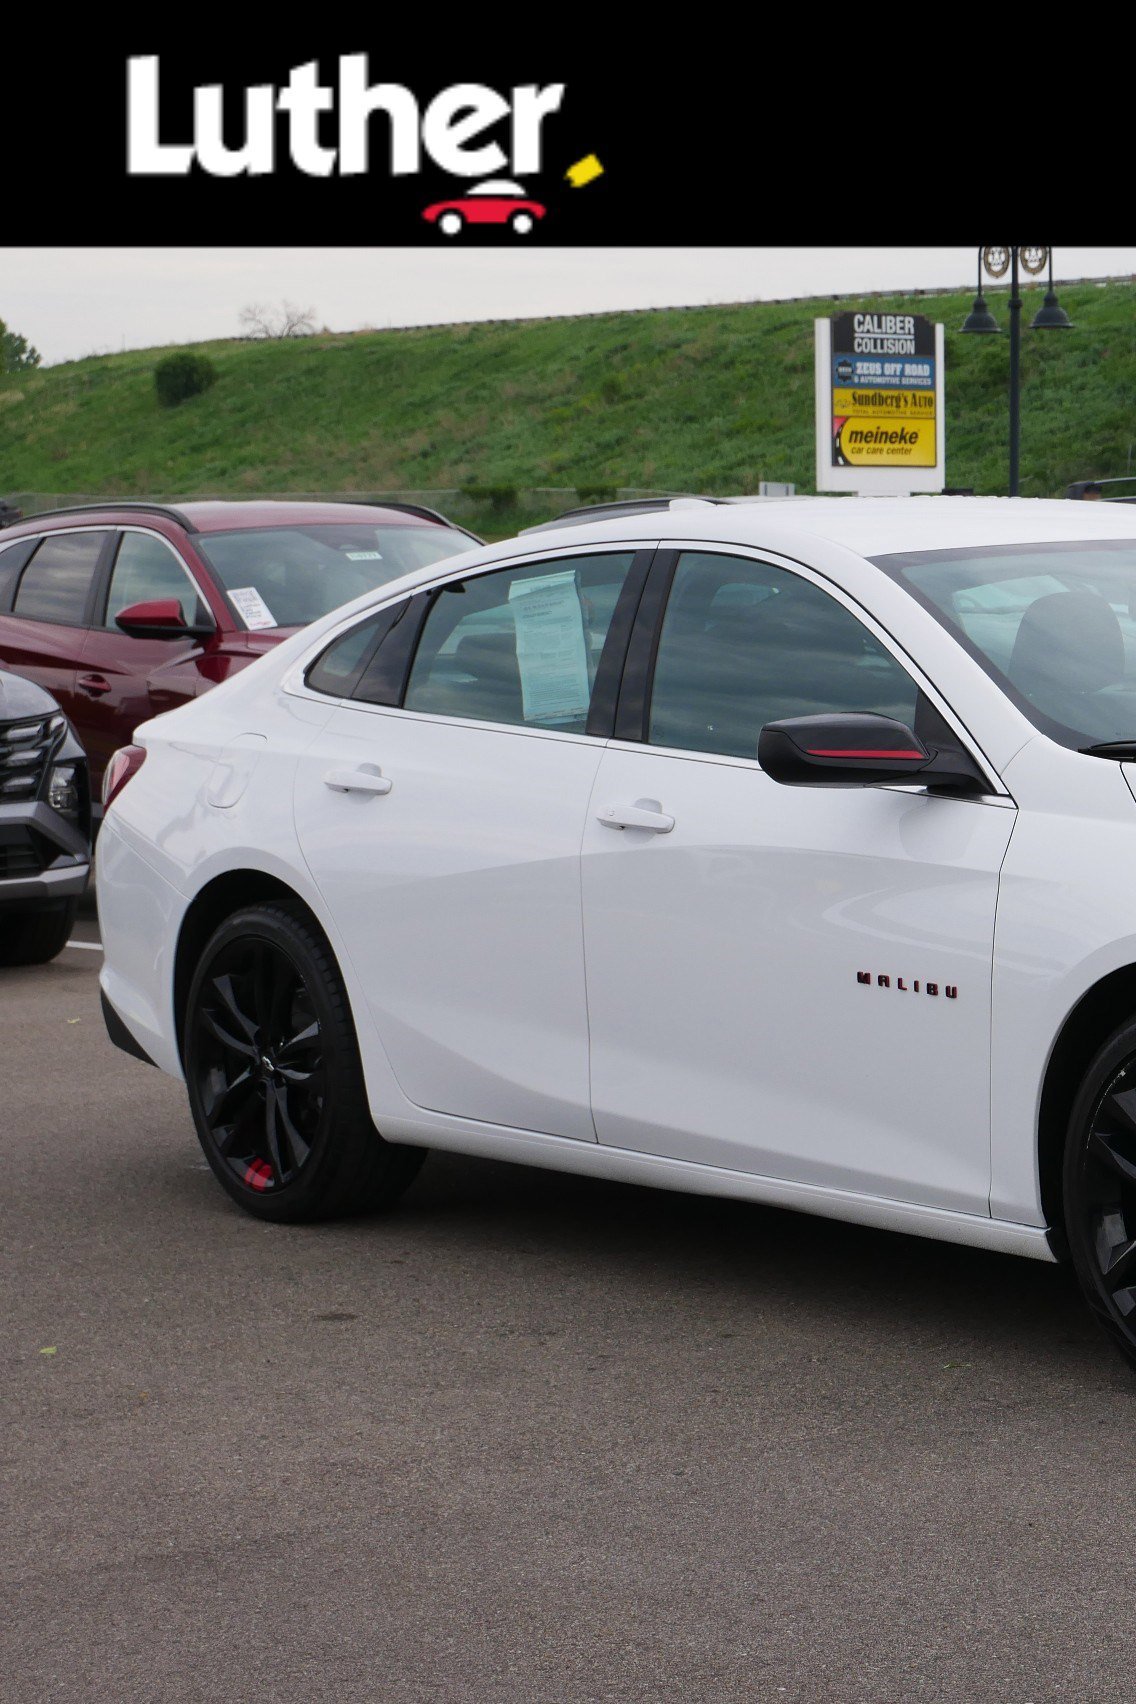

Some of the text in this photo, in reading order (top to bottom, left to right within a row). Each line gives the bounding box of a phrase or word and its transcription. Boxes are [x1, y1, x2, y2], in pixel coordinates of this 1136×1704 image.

[853, 313, 915, 335] CALIBER
[853, 338, 916, 355] COLLISION
[855, 361, 882, 376] ZEUS
[883, 362, 903, 376] OFF
[904, 363, 930, 377] ROAD
[852, 391, 909, 409] Sundberg's
[849, 425, 919, 445] meineke
[851, 446, 912, 456] car care center
[857, 971, 958, 999] MALIBU
